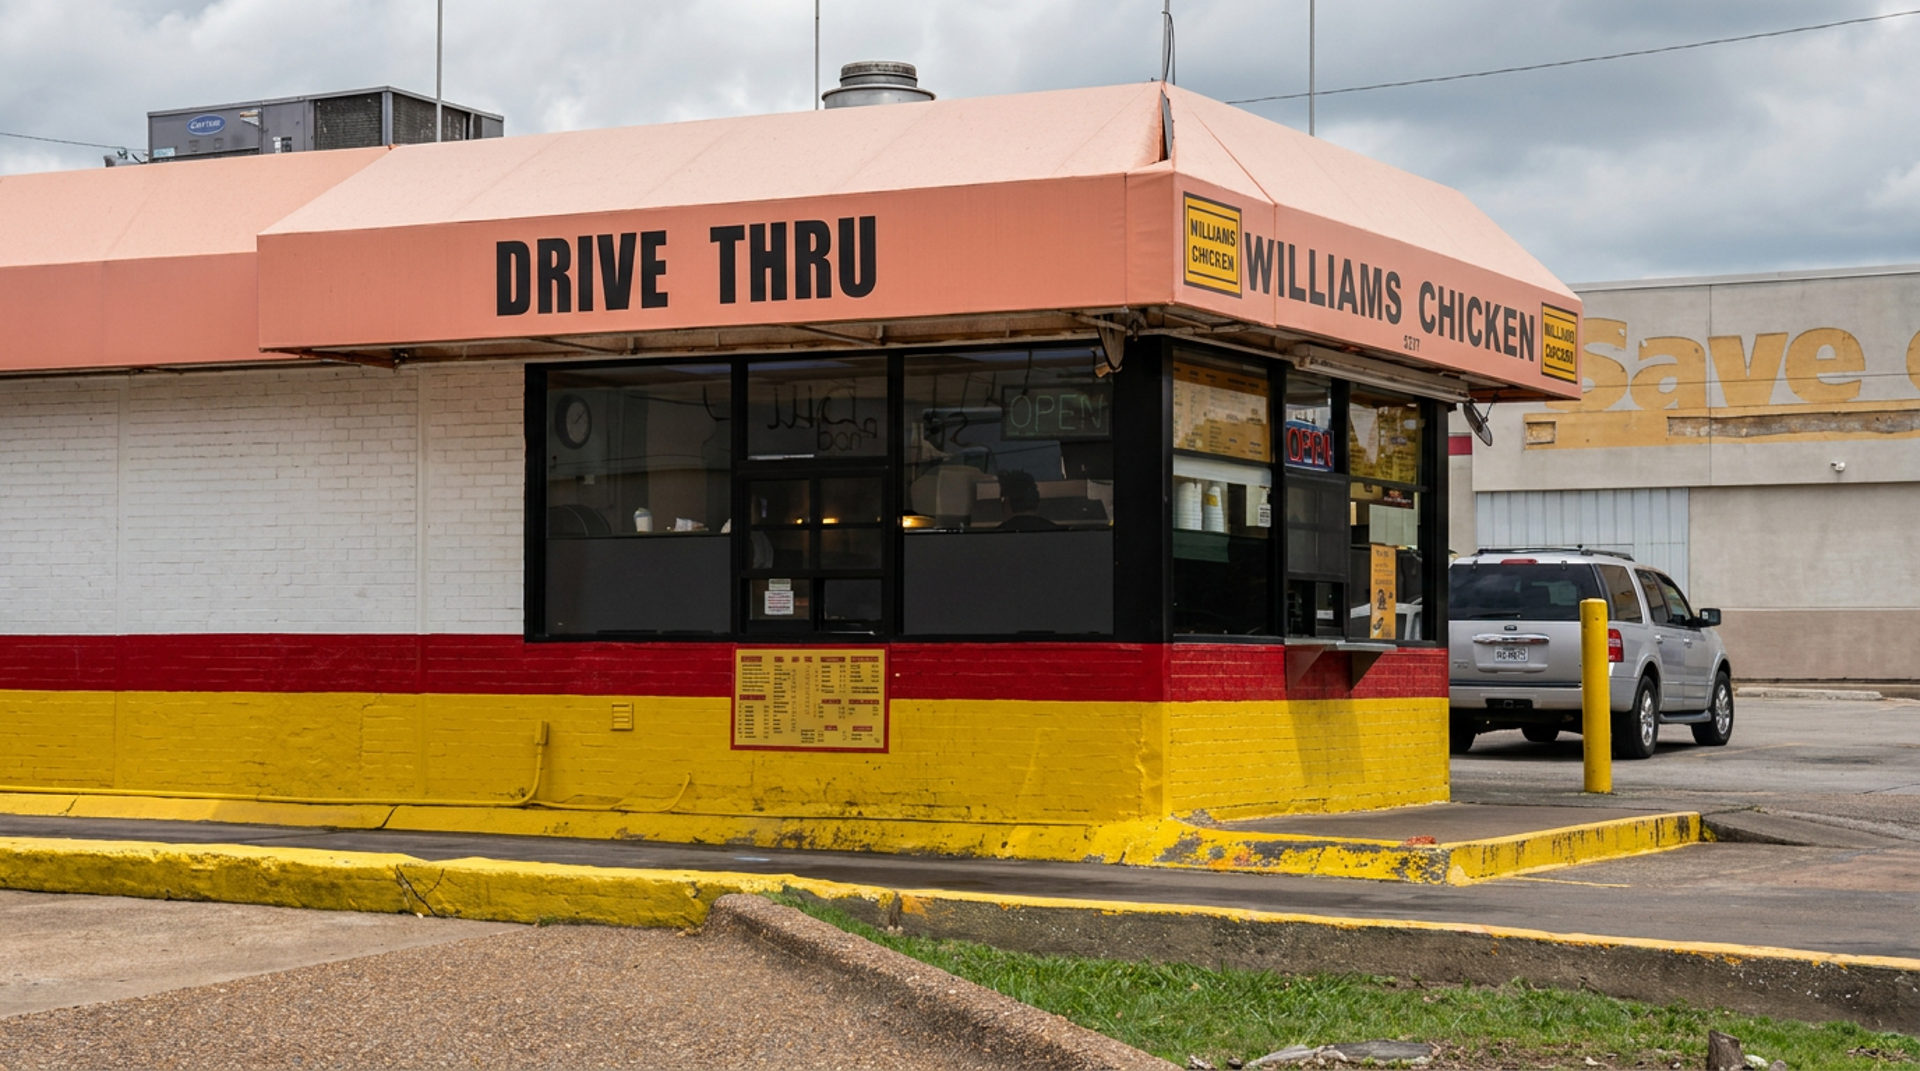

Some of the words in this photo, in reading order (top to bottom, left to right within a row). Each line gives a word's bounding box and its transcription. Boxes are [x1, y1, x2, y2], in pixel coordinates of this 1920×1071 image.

[496, 230, 669, 317] DRIVE
[710, 215, 877, 304] THRU
[1244, 231, 1402, 325] WILLIAMS
[1418, 280, 1535, 362] CHICKEN
[1009, 393, 1104, 432] OPEN
[1546, 317, 1866, 413] Save
